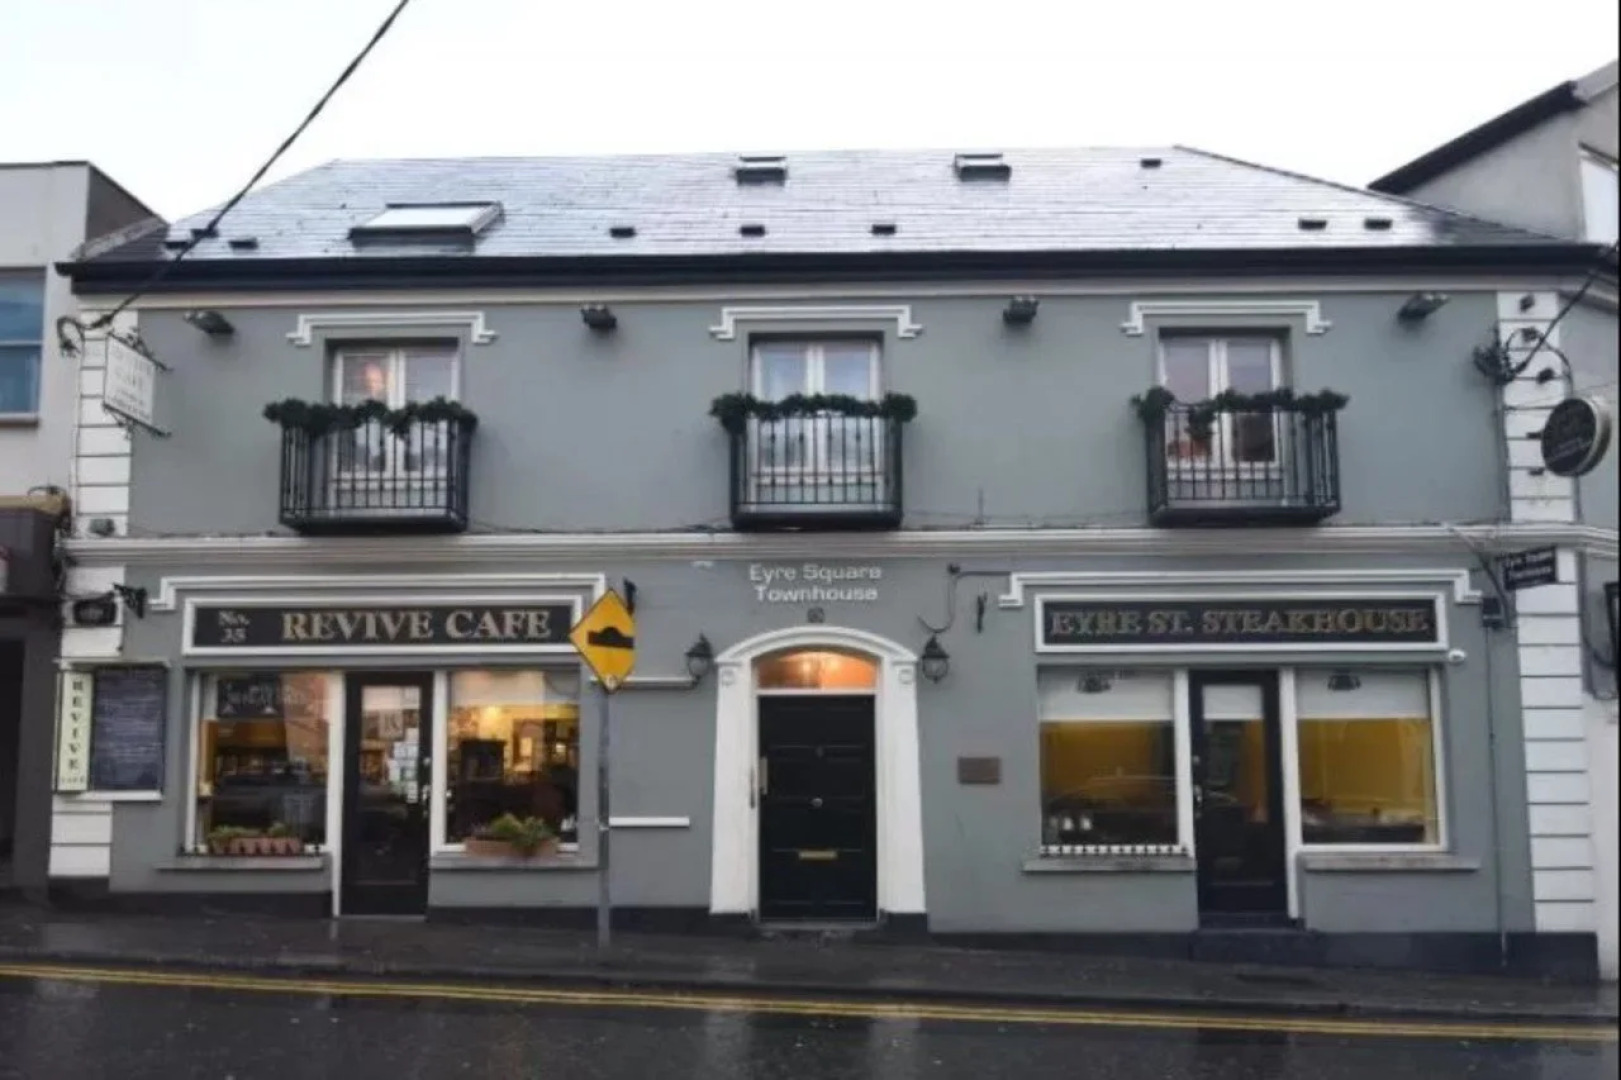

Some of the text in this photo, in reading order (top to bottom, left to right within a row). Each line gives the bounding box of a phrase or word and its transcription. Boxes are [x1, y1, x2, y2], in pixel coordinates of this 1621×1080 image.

[750, 563, 881, 586] Eyre Square
[755, 584, 878, 602] Townhouse
[281, 610, 551, 641] REVIVE CAFE
[1050, 609, 1428, 635] EYRE ST. STEAKHOUSE
[69, 681, 83, 770] REVIVE
